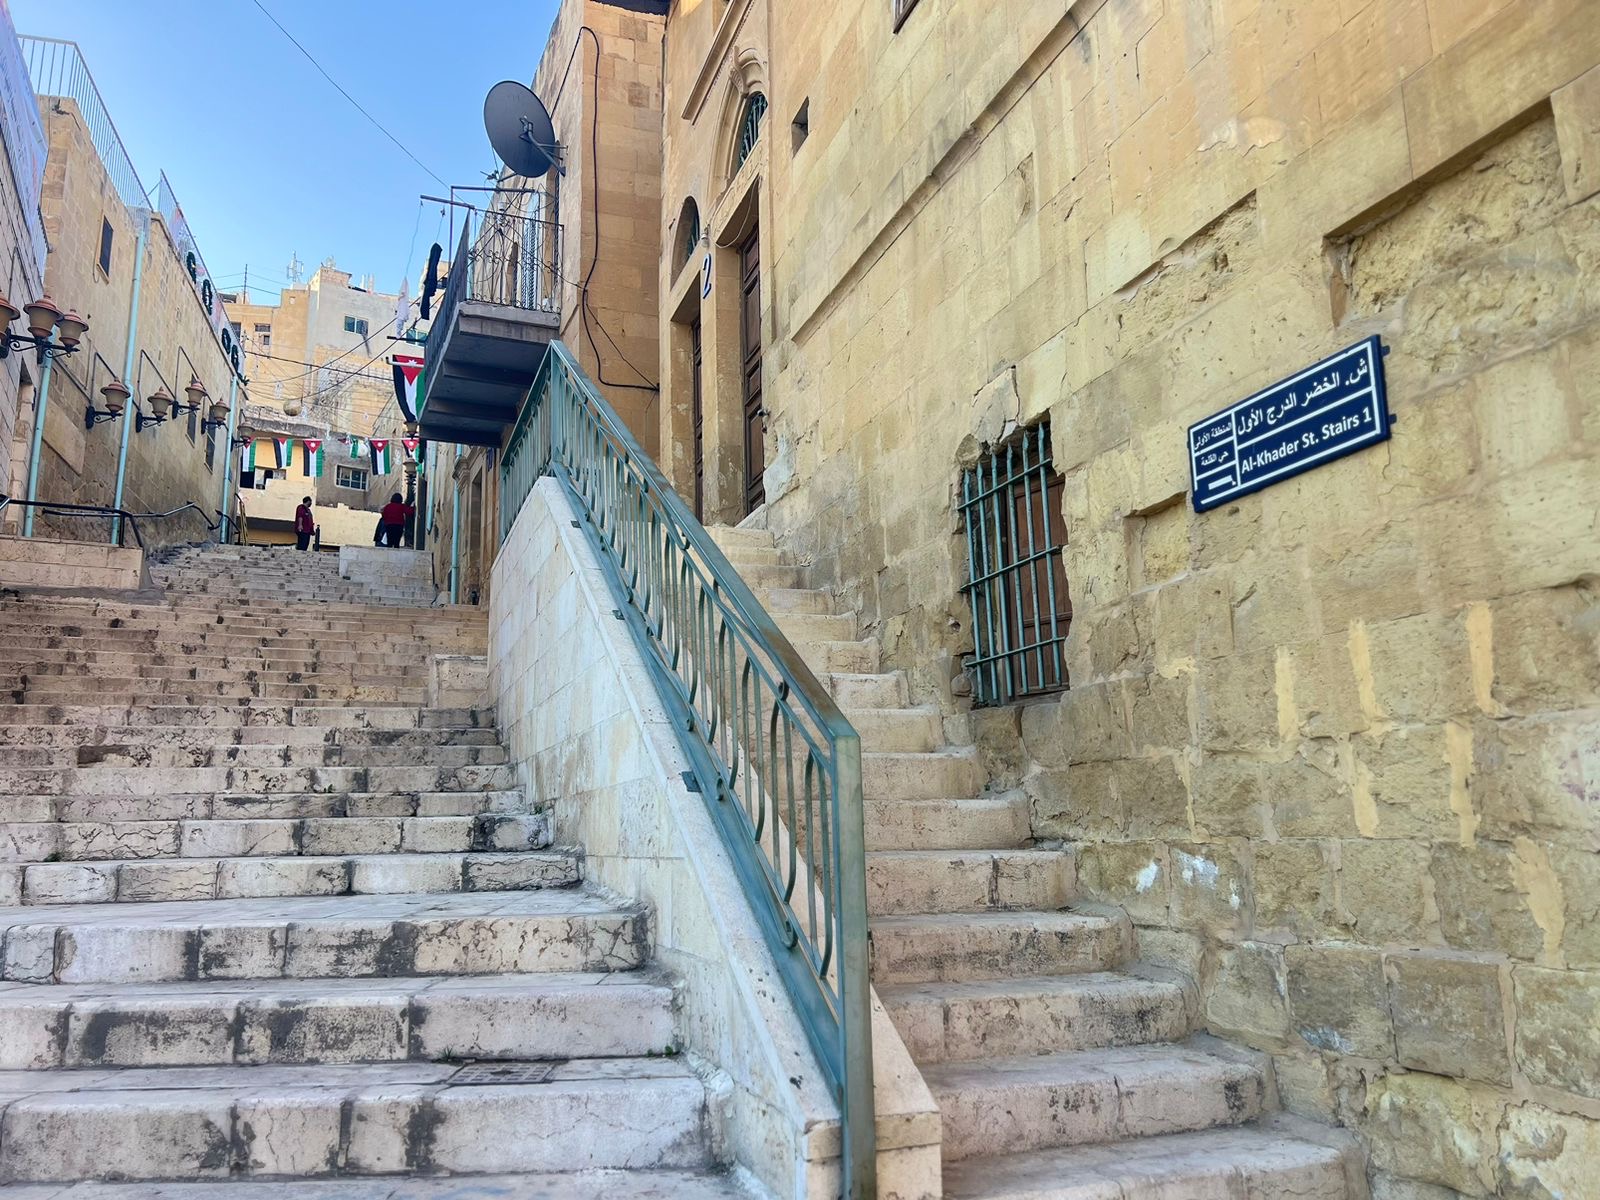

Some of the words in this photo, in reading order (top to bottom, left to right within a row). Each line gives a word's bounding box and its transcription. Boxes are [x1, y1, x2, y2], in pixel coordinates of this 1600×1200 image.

[1345, 358, 1368, 386] ش.
[1301, 371, 1340, 407] الخضر
[1237, 408, 1263, 435] الأول
[1266, 392, 1297, 425] الدرج
[1210, 422, 1232, 437] المنطقة
[1241, 439, 1299, 474] Al-Khader
[1301, 432, 1319, 449] St.
[1321, 414, 1360, 440] Stairs
[1362, 406, 1372, 423] 1
[1218, 451, 1229, 463] حي
